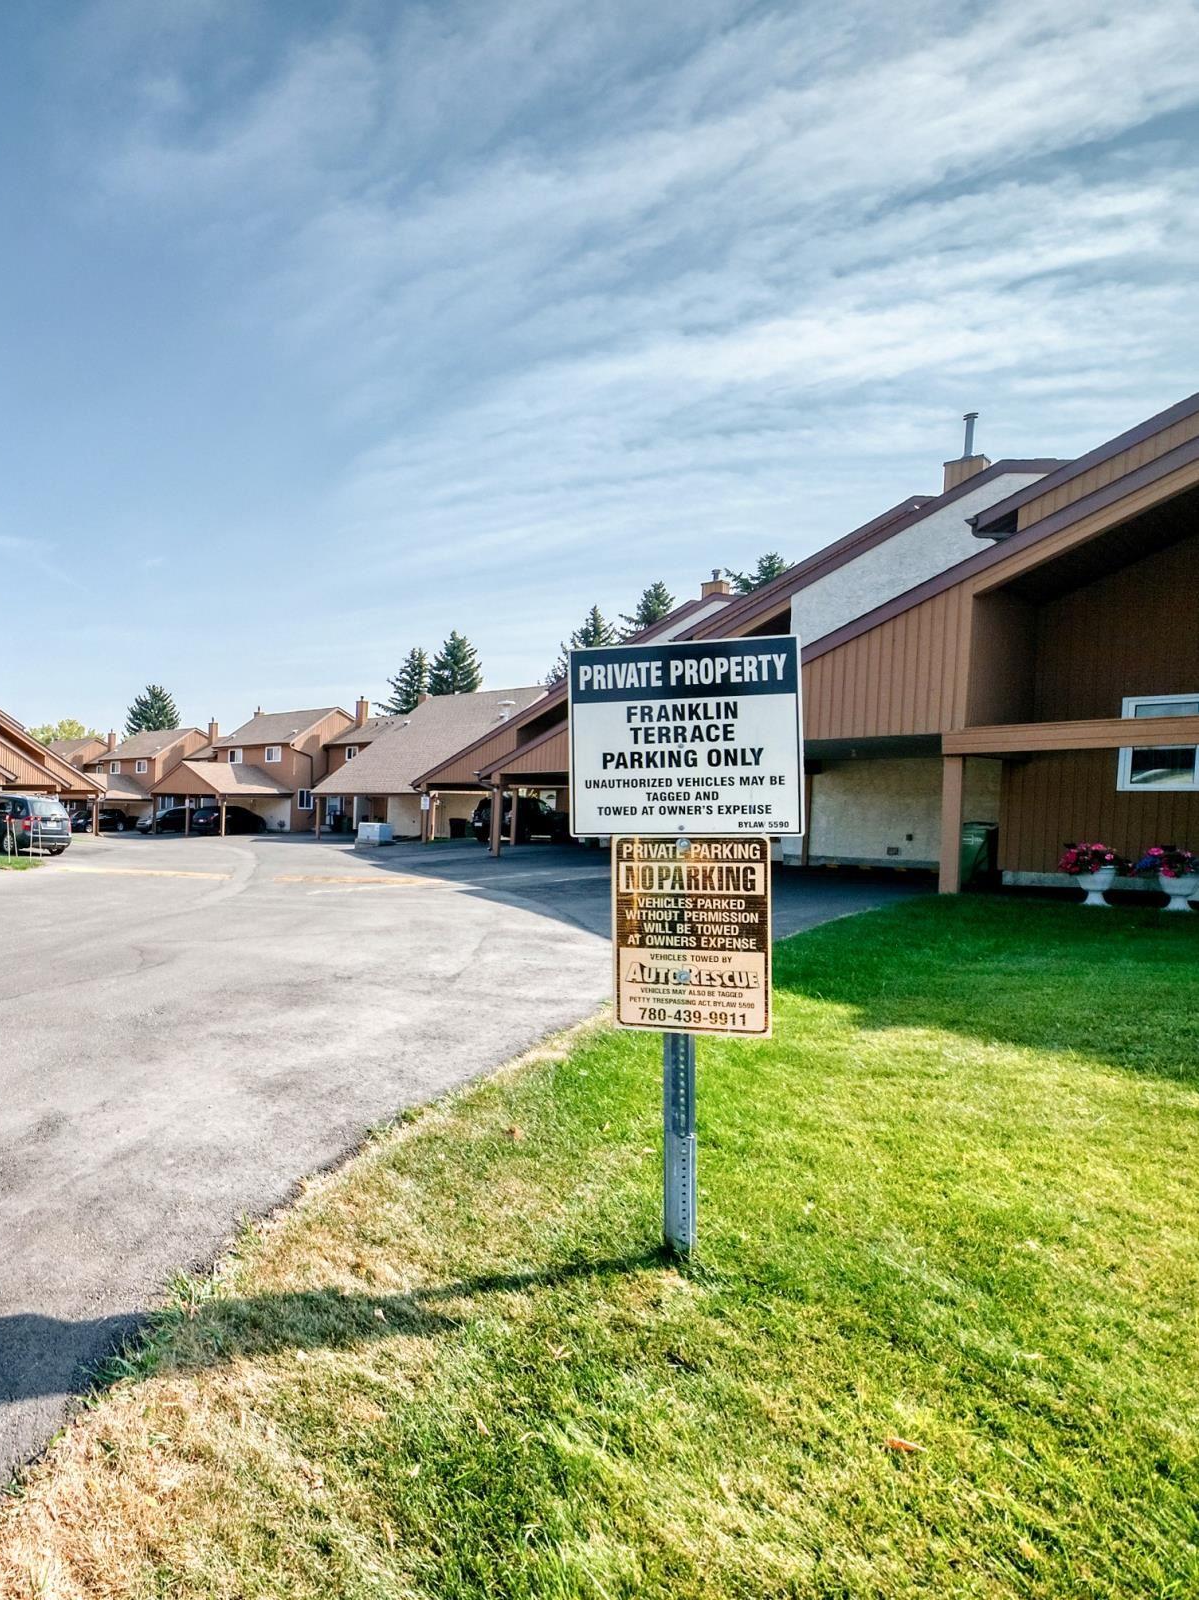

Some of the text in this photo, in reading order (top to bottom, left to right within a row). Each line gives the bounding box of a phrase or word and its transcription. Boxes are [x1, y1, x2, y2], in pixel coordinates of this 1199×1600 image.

[579, 653, 787, 691] PRIVATE PROPERTY
[626, 701, 738, 724] FRANKLIN
[630, 723, 735, 745] TERRACE
[602, 747, 764, 770] PARKING ONLY
[585, 775, 786, 789] UNAUTHORIZED VEHICLES MAY BE
[646, 791, 719, 802] TAGGED AND
[597, 804, 772, 816] TOWED AT OWNER'S EXPENSE
[768, 820, 790, 829] 5590
[691, 844, 761, 859] PARKING
[637, 897, 745, 910] VEHICLES PARKED
[625, 909, 759, 924] WITHOUT PERMISSION
[643, 922, 739, 936] WILL BE TOWED
[627, 934, 757, 950] AT OWNERS EXPENSE
[650, 953, 732, 964] VEHICLES TOWED BY
[640, 987, 671, 995] VEHICLES
[672, 988, 686, 996] MAY
[688, 989, 706, 997] ALSO
[717, 991, 743, 999] TAGGED
[629, 996, 650, 1004] PETTY
[653, 997, 696, 1006] TRESPASSING
[639, 1007, 746, 1027] 780-439-9911
